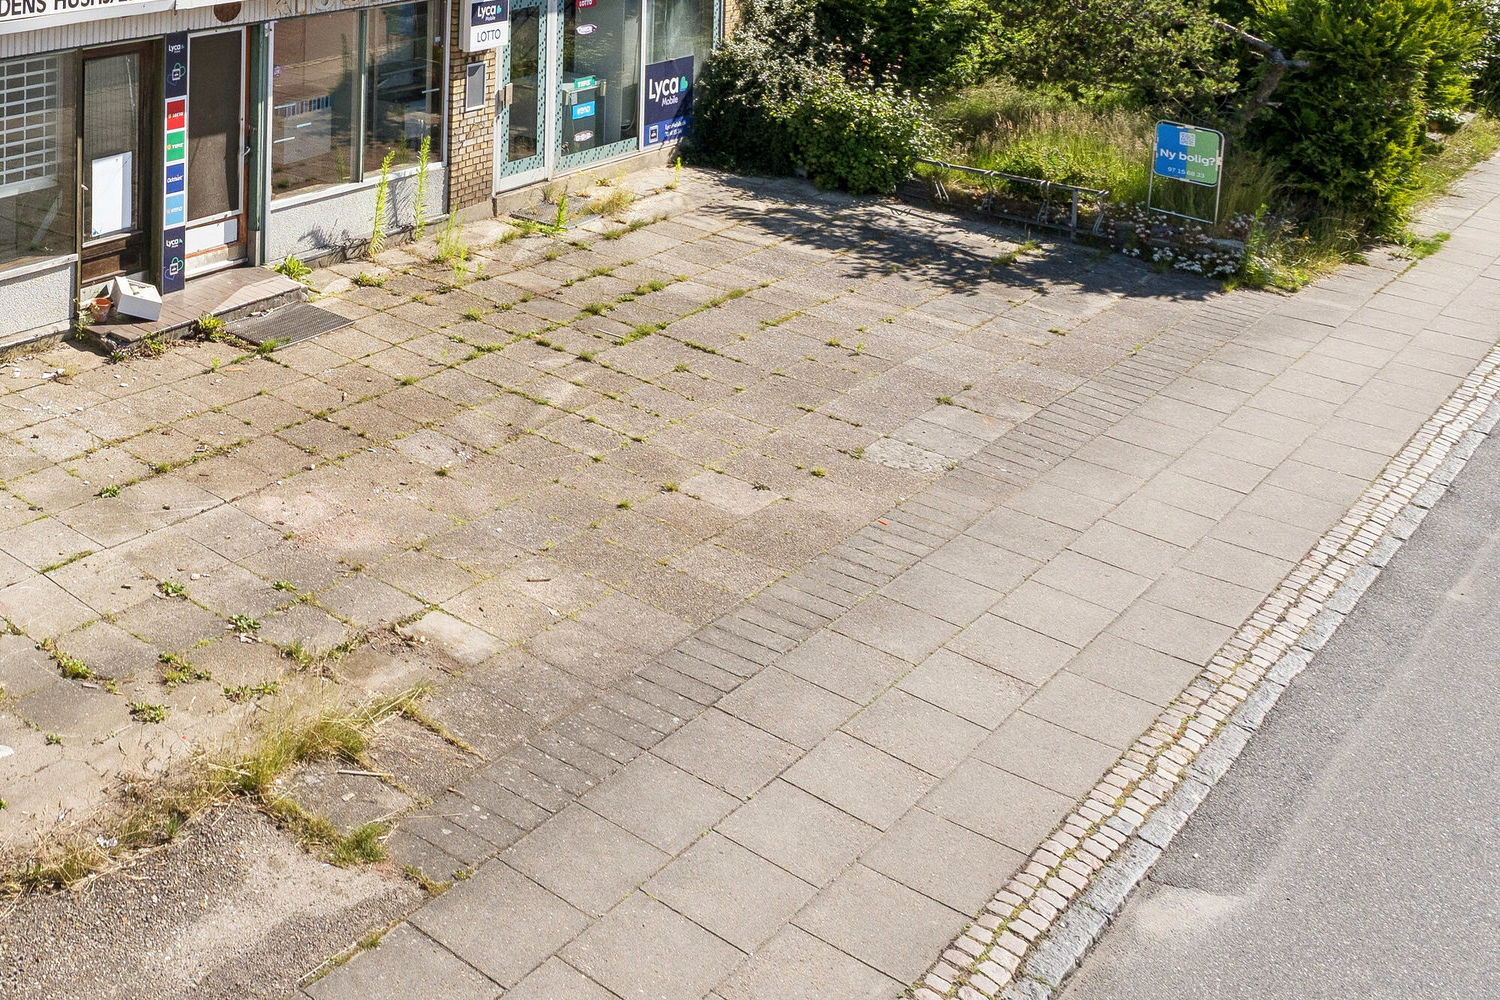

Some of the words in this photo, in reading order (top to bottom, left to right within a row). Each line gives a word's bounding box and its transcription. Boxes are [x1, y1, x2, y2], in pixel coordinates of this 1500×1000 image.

[477, 4, 497, 19] Lyca
[476, 29, 501, 43] LOTTO
[648, 76, 679, 102] Lyca
[661, 95, 679, 107] Mobile
[1160, 148, 1176, 160] Ny
[1179, 151, 1216, 167] bolig?
